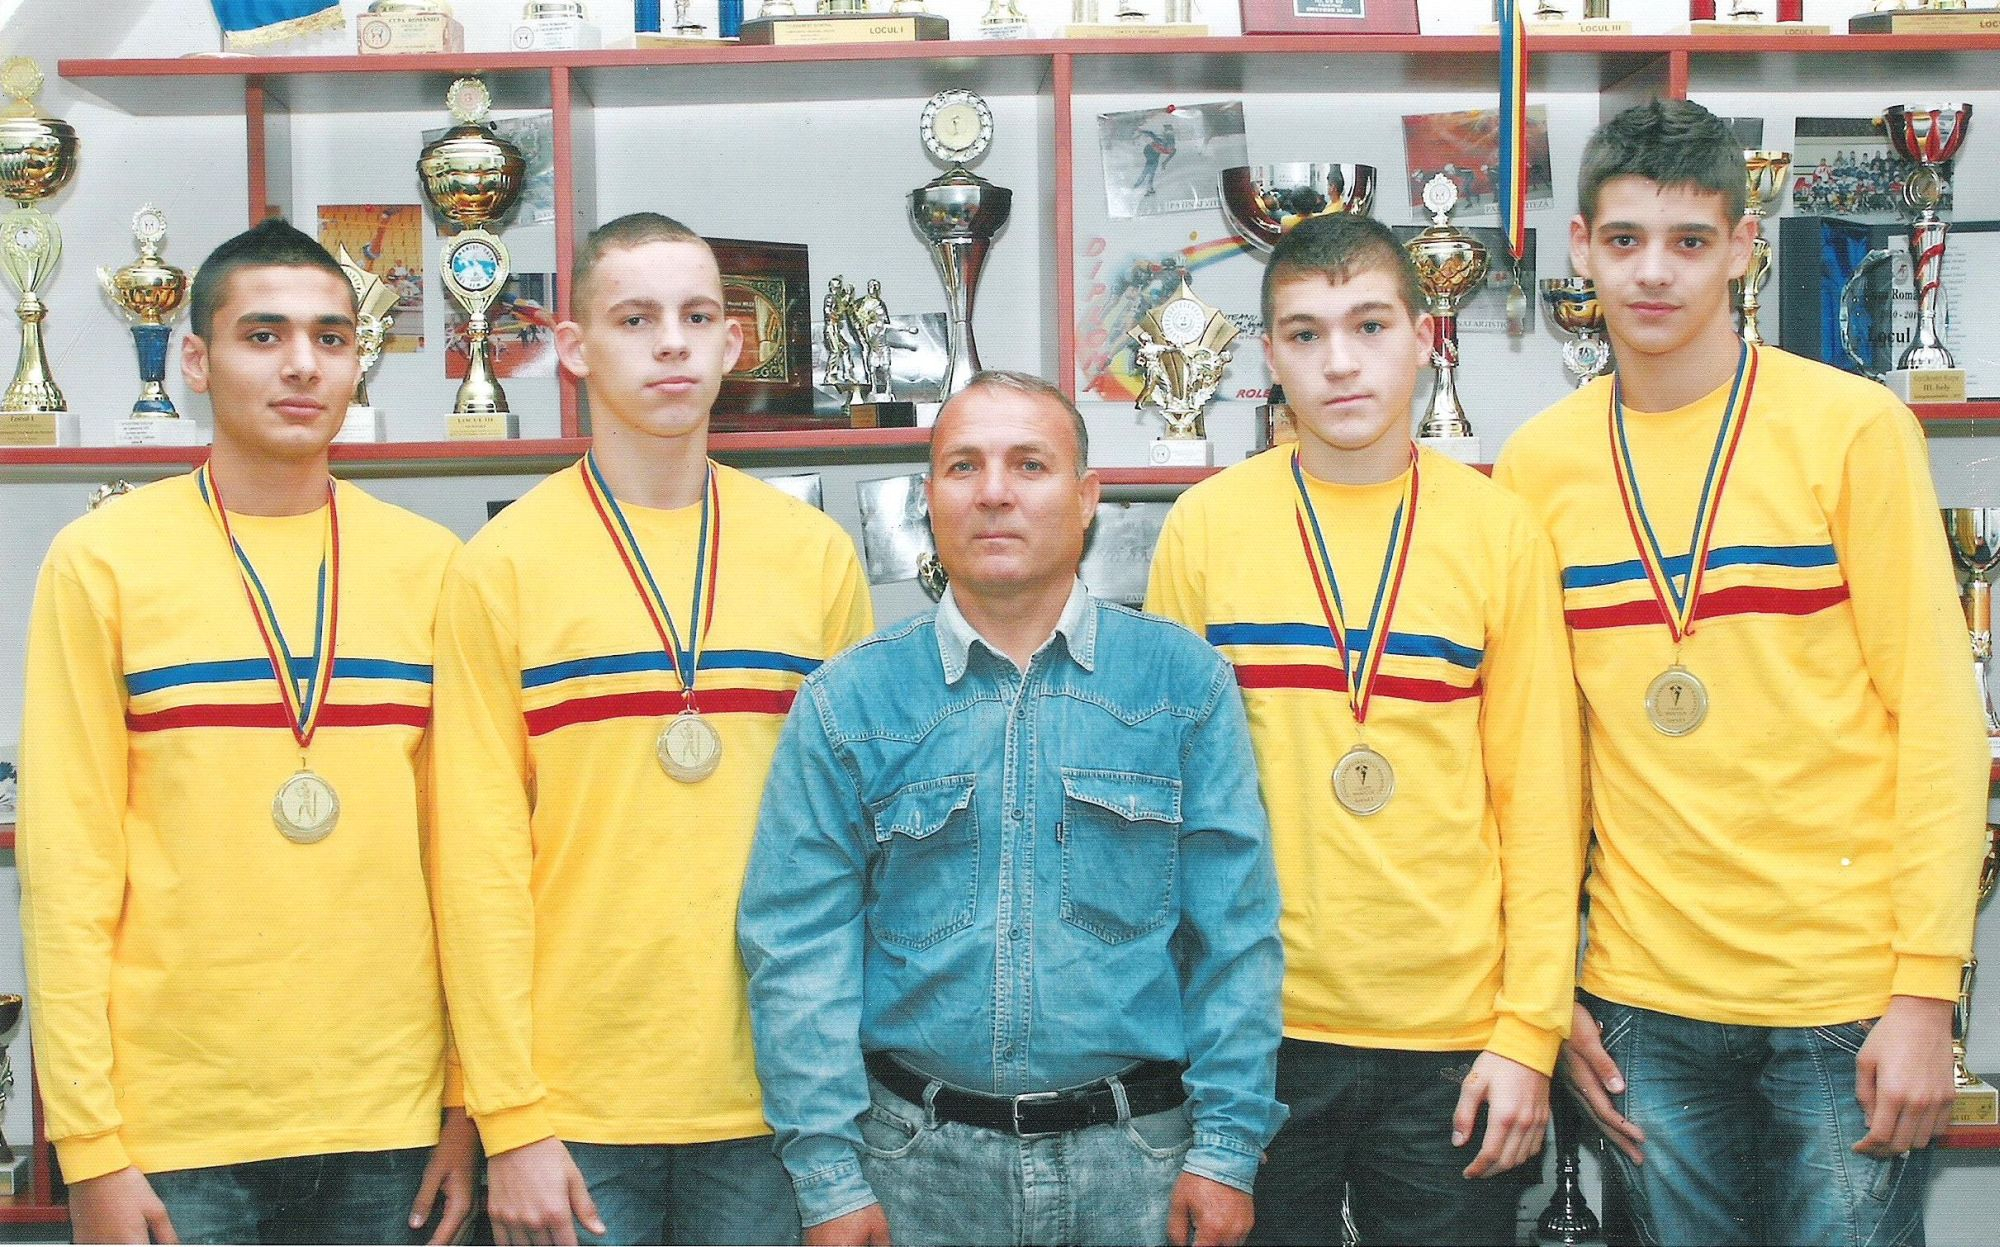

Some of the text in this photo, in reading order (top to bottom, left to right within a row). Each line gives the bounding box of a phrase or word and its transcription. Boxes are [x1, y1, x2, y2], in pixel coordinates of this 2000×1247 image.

[1979, 20, 2000, 29] LOC
[869, 26, 898, 34] LOCUL
[1580, 25, 1609, 33] LOCUL
